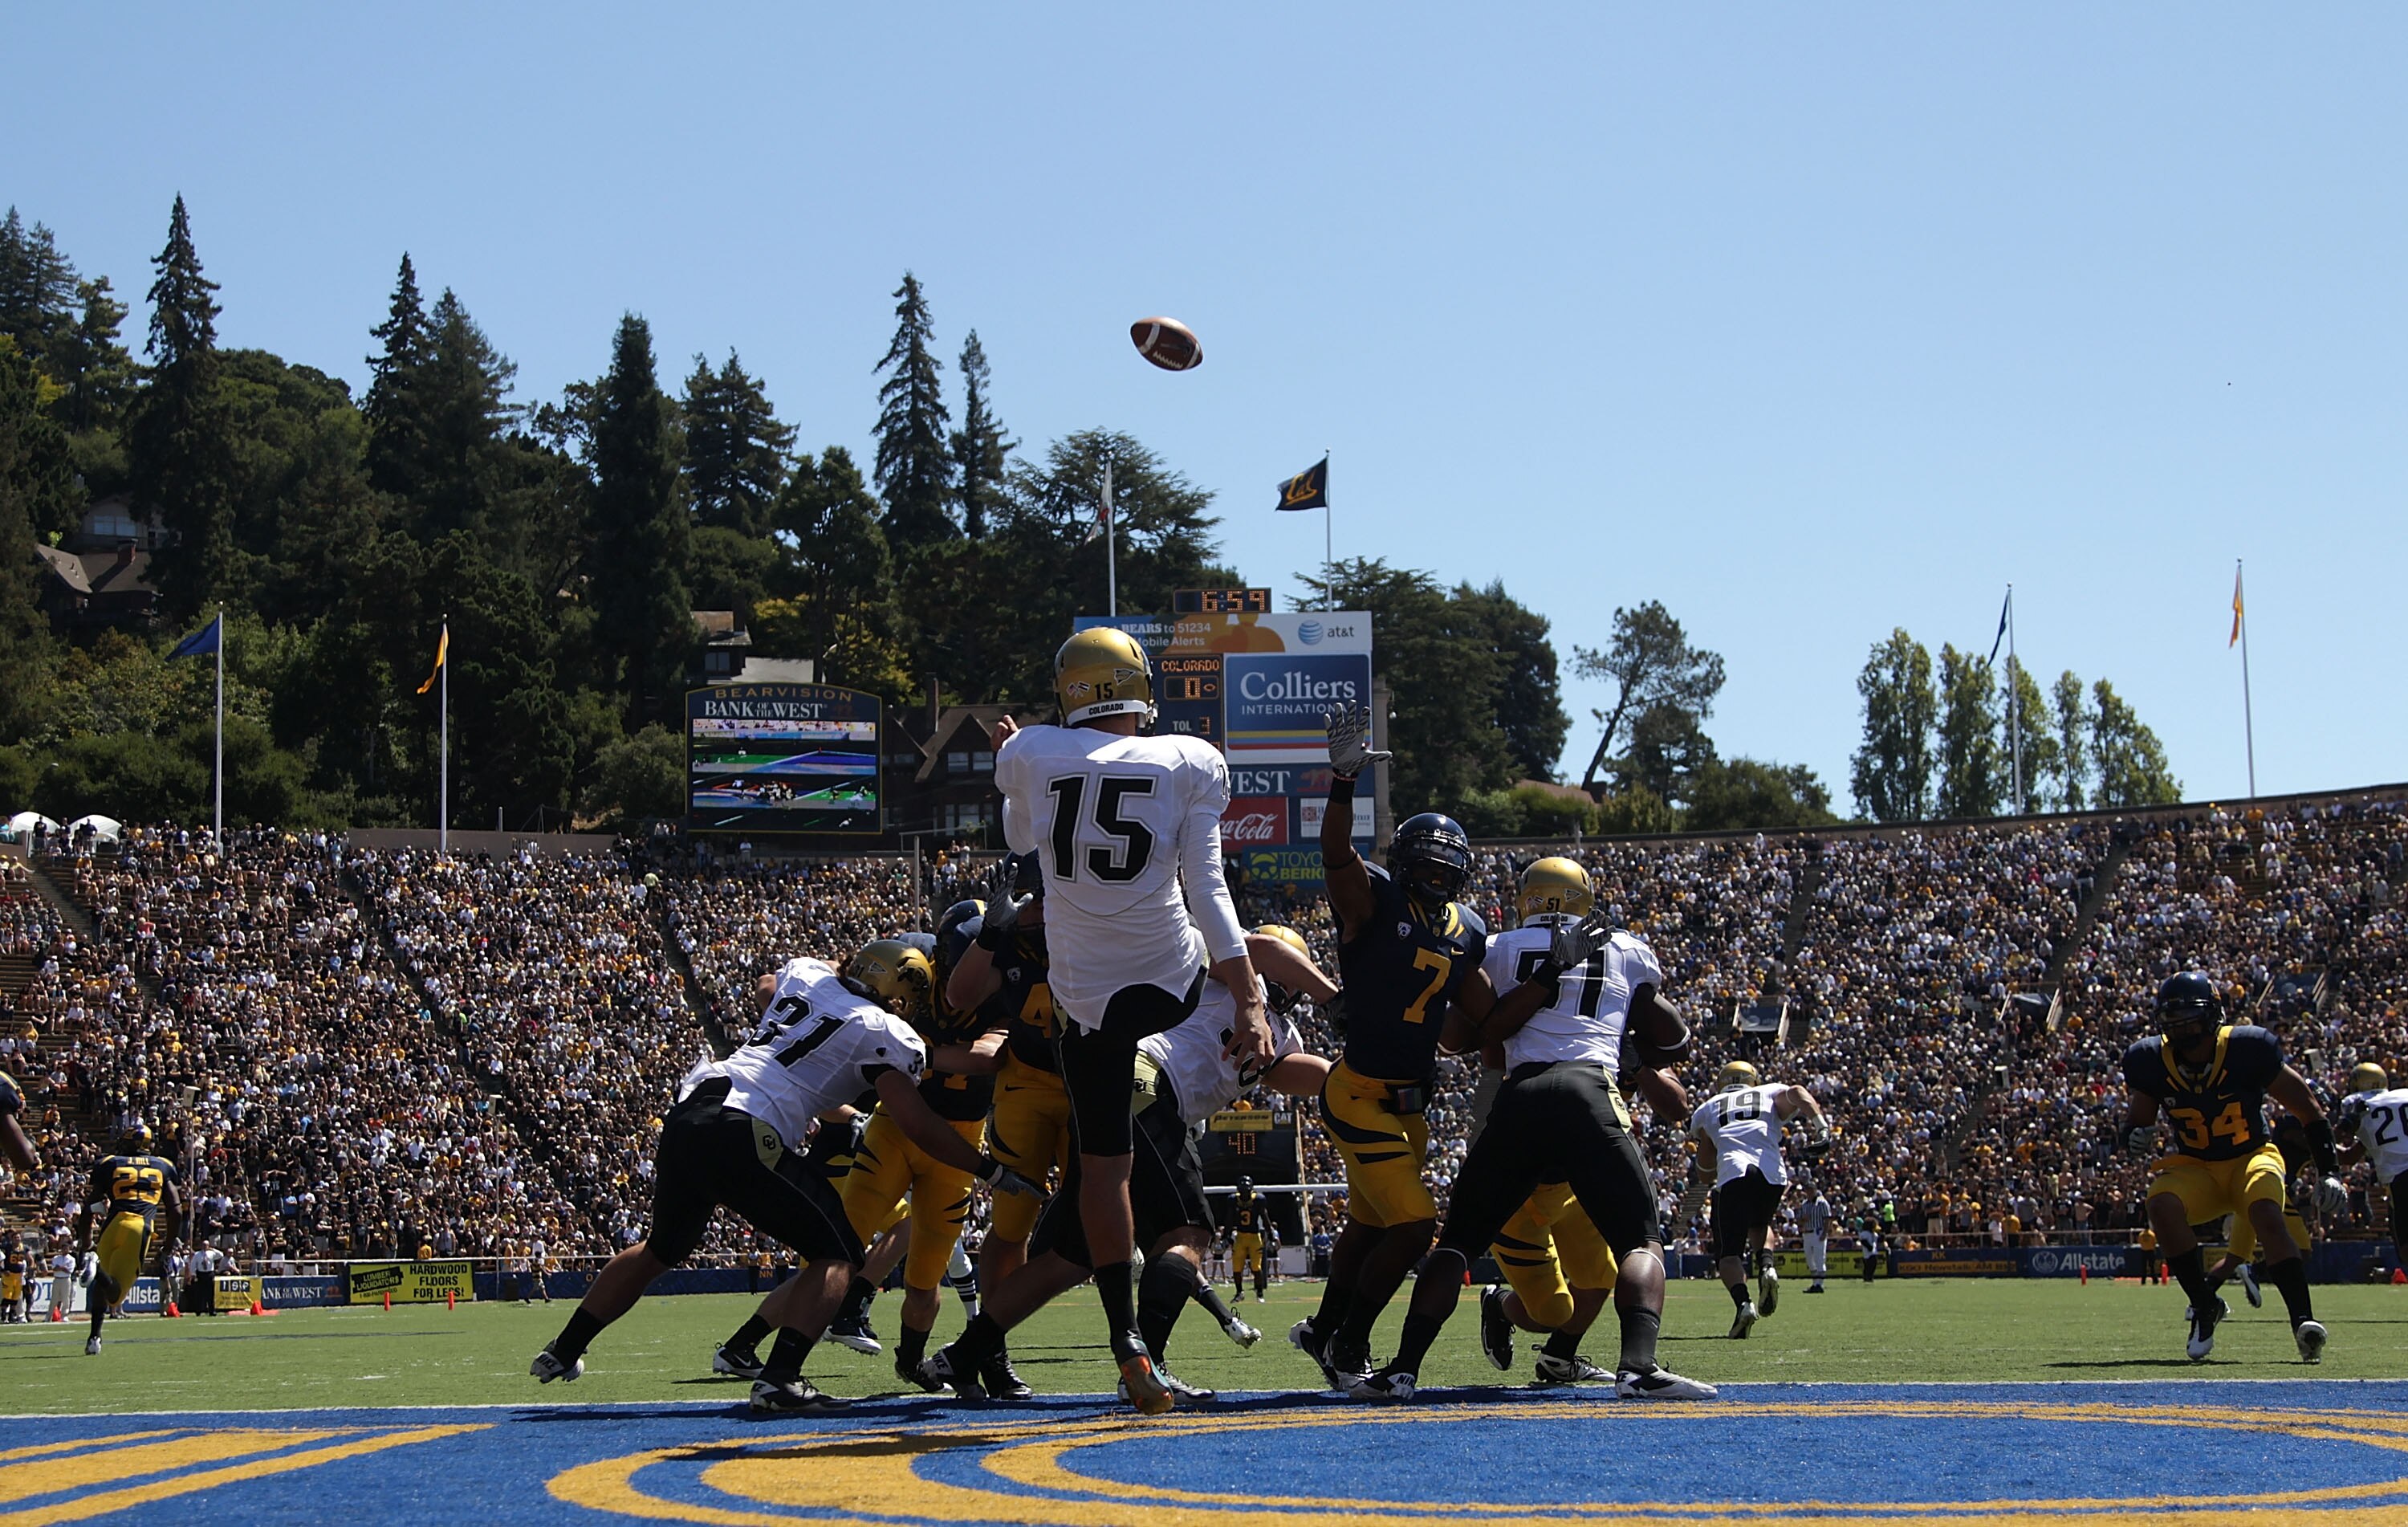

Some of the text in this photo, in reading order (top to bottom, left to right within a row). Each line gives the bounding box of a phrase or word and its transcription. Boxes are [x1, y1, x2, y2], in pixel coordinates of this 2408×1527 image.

[1202, 590, 1265, 611] 6:59
[1121, 623, 1162, 634] BEARS
[1164, 624, 1175, 633] to
[1178, 622, 1211, 633] 51234
[1327, 625, 1354, 637] at&t
[1171, 636, 1206, 646] Alerts
[1094, 682, 1114, 701] 15
[1240, 671, 1356, 700] Colliers
[714, 686, 852, 702] BEARVISION
[705, 700, 755, 717] BANK
[757, 702, 771, 711] OF
[772, 702, 823, 719] WEST
[1088, 702, 1124, 715] COLORADO
[1242, 702, 1348, 715] INTERNATION
[1172, 720, 1192, 732] TOL
[1045, 771, 1159, 885] 15
[1279, 851, 1324, 867] TOYO
[1280, 867, 1324, 880] BERK
[1546, 898, 1561, 911] 51
[1402, 947, 1452, 1024] 7
[745, 993, 850, 1071] 31
[1714, 1089, 1762, 1129] 19
[1274, 1112, 1293, 1124] CAT
[2169, 1101, 2251, 1150] 34
[1228, 1133, 1255, 1154] 40
[112, 1167, 164, 1205] 23
[1240, 1211, 1251, 1225] 3
[2060, 1252, 2125, 1271] Allstate
[363, 1271, 391, 1282] LUMBER
[409, 1264, 467, 1276] HARDWOOD
[419, 1275, 458, 1286] FLOORS
[121, 1285, 161, 1305] Allsta
[262, 1287, 282, 1300] ANK
[292, 1286, 323, 1299] WEST
[413, 1287, 434, 1298] FOR
